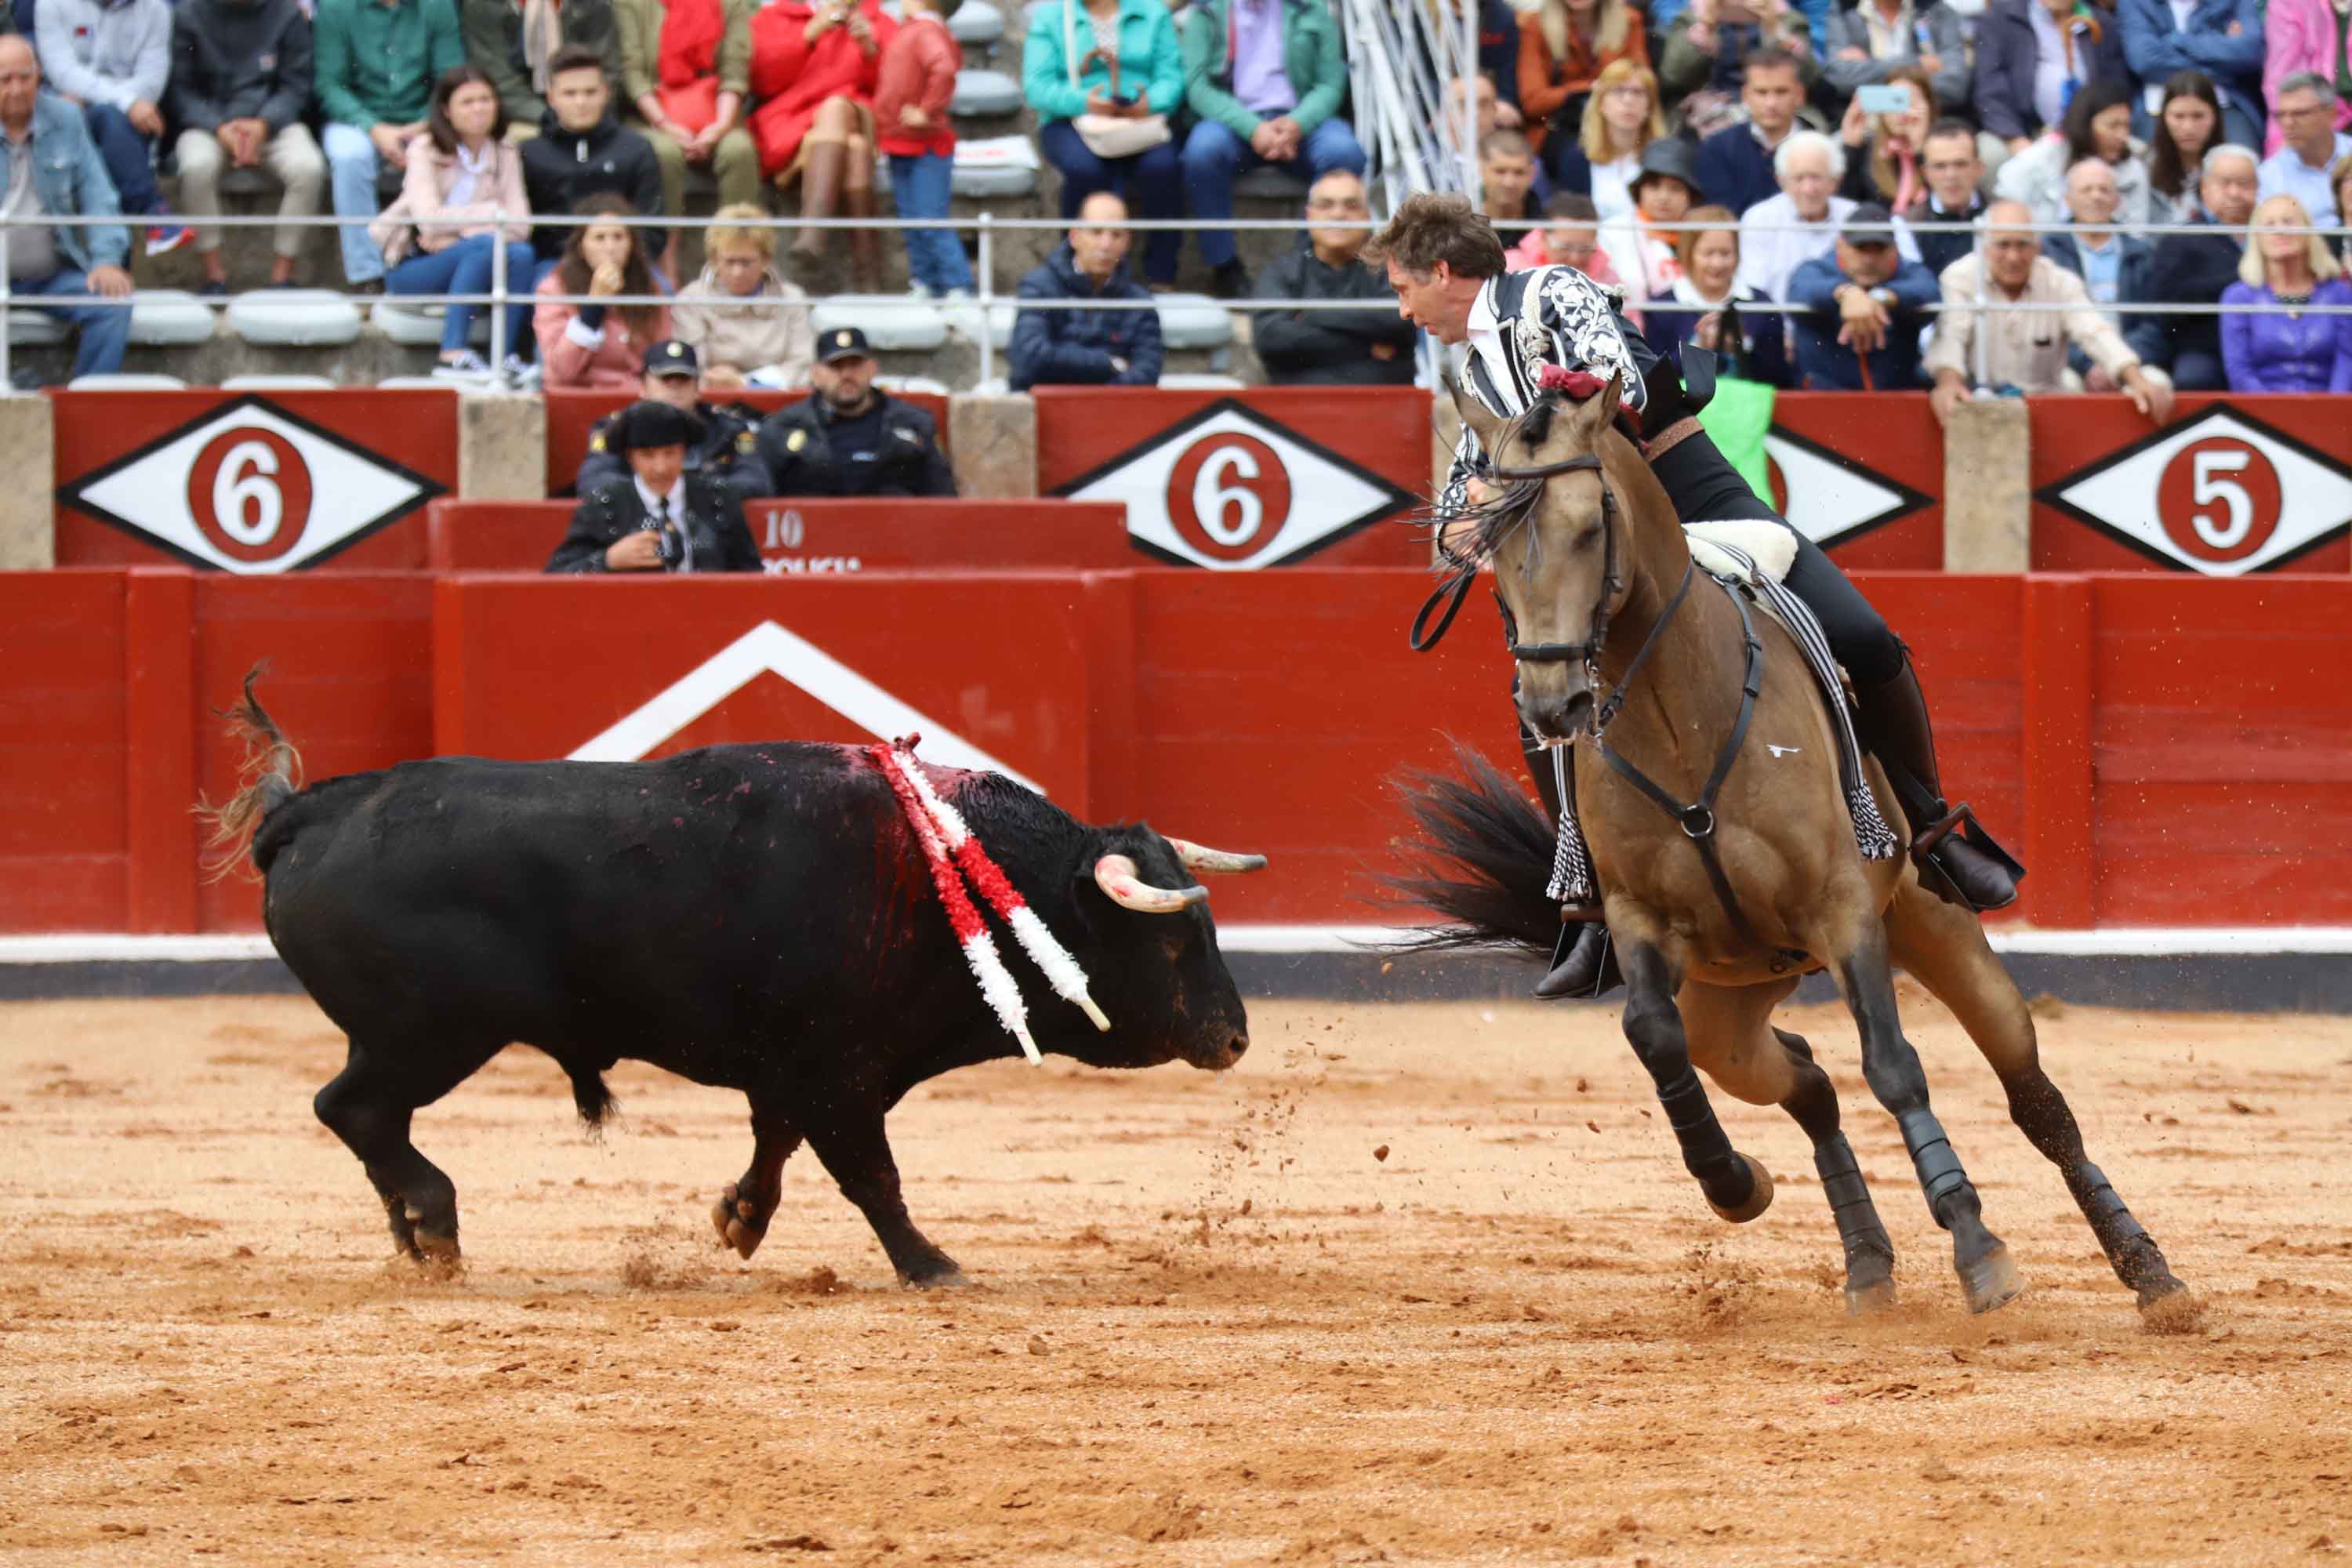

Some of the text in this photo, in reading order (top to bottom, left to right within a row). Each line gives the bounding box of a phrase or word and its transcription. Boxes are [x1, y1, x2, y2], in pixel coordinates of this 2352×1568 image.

[212, 441, 283, 546] 6
[764, 510, 804, 548] 10
[1192, 445, 1262, 546] 6
[2192, 451, 2254, 549] 5
